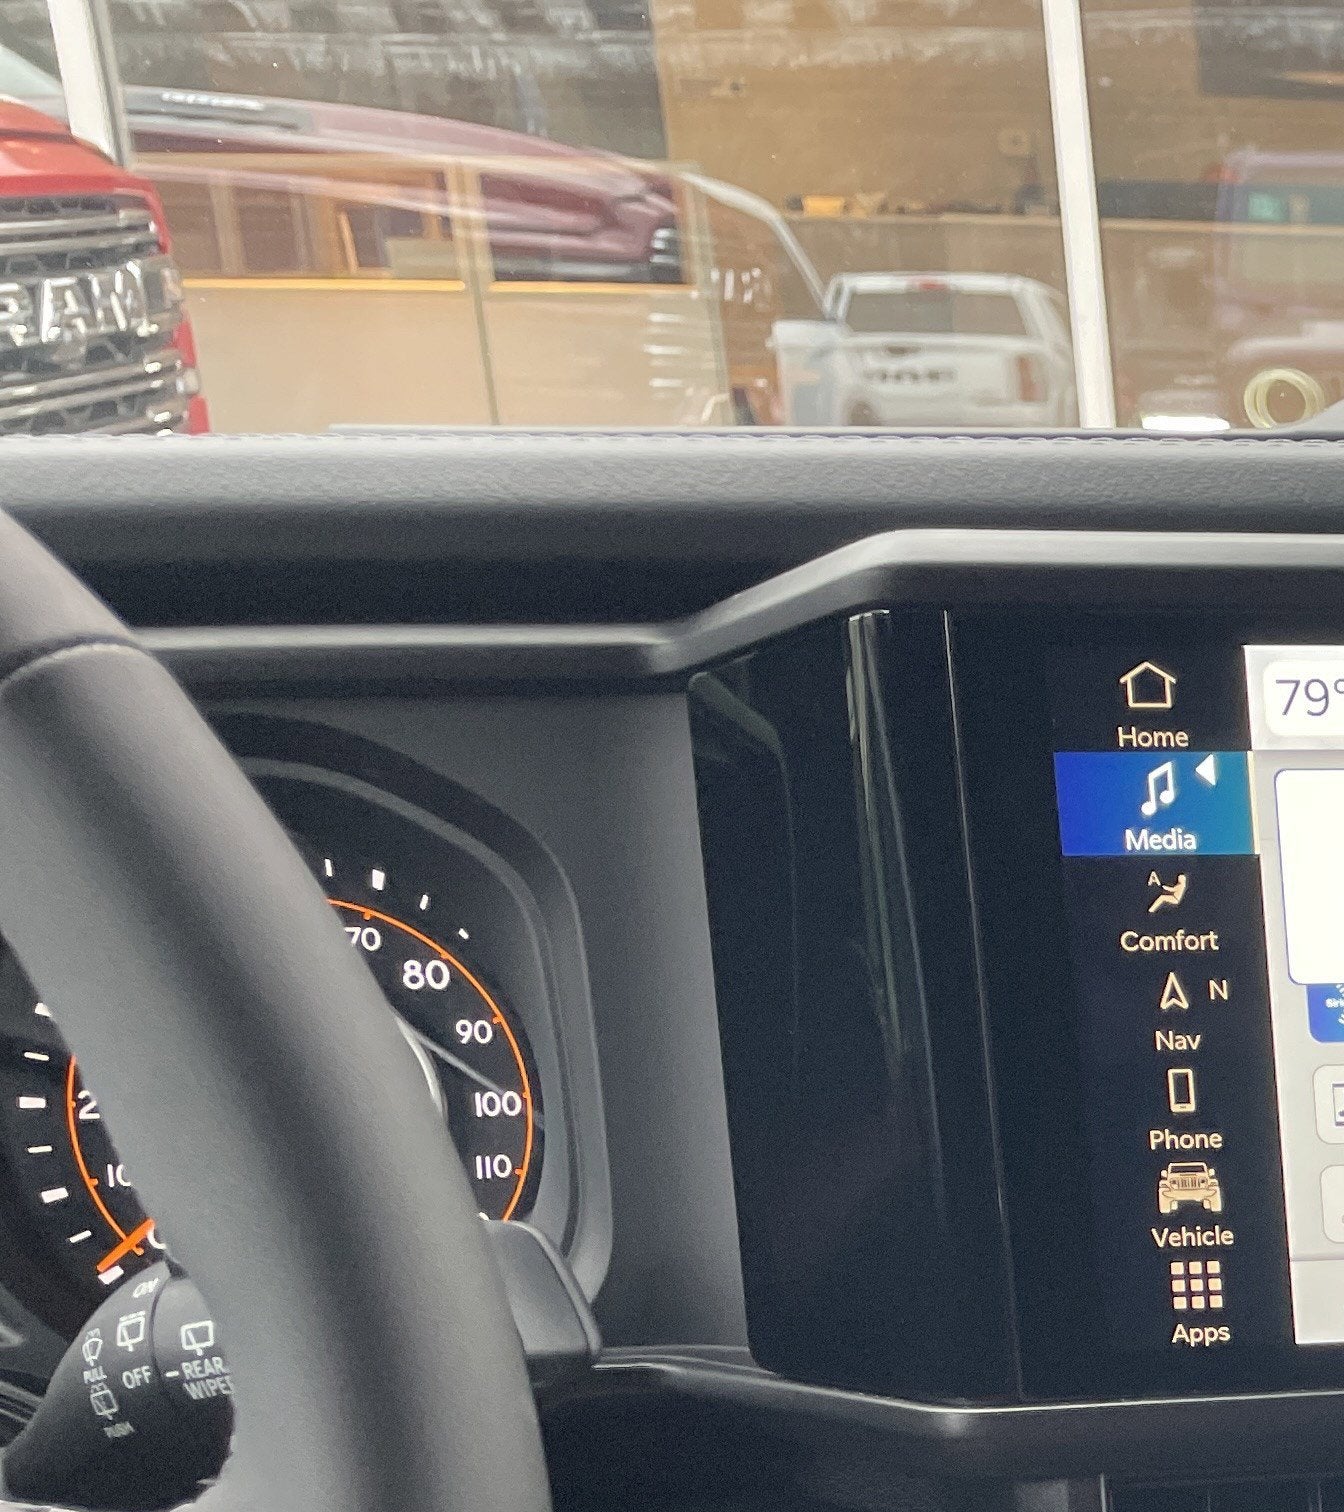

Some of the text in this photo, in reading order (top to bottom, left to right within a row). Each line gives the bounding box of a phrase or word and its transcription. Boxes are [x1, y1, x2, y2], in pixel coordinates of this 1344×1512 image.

[1117, 726, 1189, 749] Home
[1125, 828, 1197, 851] Media
[345, 927, 381, 951] 70
[1120, 930, 1219, 952] Comfort
[402, 959, 450, 990] 80
[455, 1019, 493, 1044] 90
[1155, 1031, 1201, 1051] Nav
[474, 1091, 522, 1117] 100
[1149, 1130, 1223, 1150] Phone
[475, 1154, 512, 1180] 110
[1151, 1225, 1234, 1249] Vehicle
[1172, 1323, 1231, 1347] Apps
[122, 1366, 151, 1389] OFF
[181, 1356, 226, 1380] REAR
